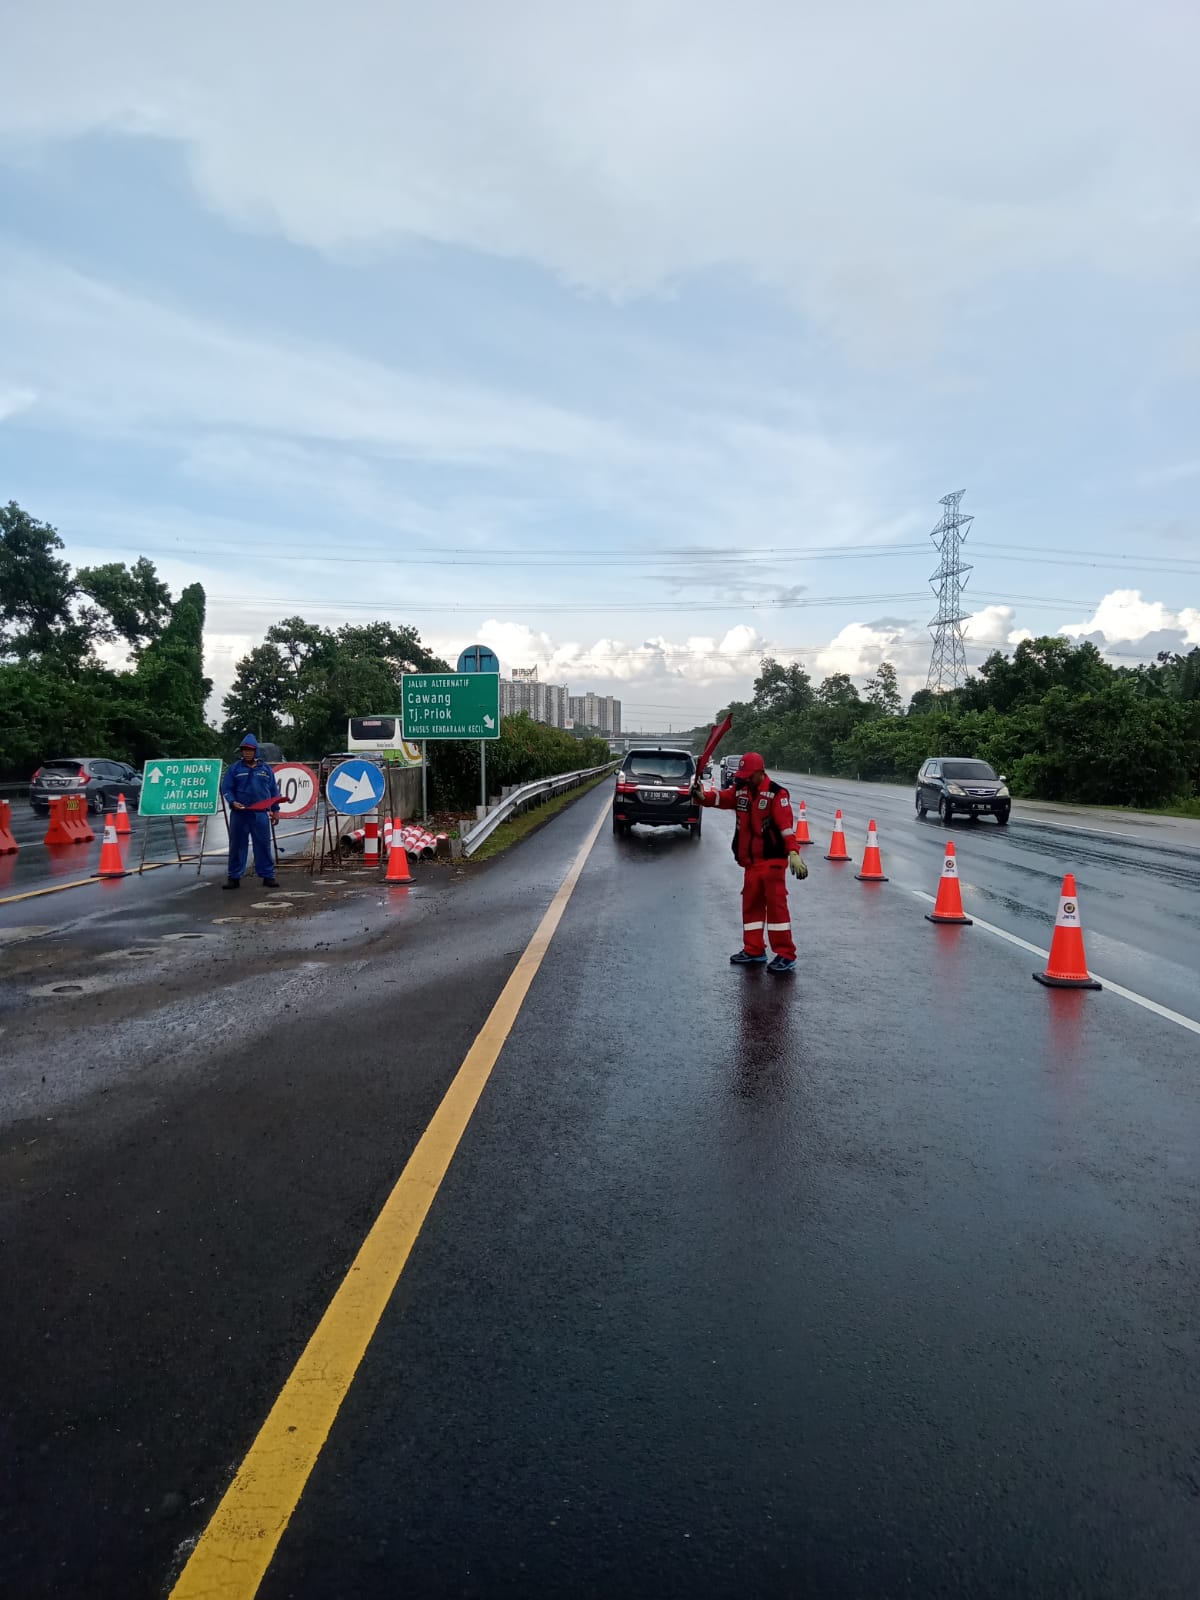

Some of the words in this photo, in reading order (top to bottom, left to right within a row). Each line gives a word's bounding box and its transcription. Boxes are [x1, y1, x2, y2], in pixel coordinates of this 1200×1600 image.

[408, 680, 427, 688] JALUR
[431, 679, 469, 688] ALTERNATIF
[407, 693, 451, 706] Cawang
[408, 708, 452, 722] Tj.Priok
[408, 725, 430, 733] KHUSUS
[432, 725, 466, 733] KENDARAAN
[468, 724, 484, 733] KECIL
[183, 764, 212, 774] INDAH
[180, 777, 206, 786] REBO
[298, 776, 310, 788] km
[164, 790, 184, 800] JATI
[186, 789, 209, 799] ASIH
[161, 802, 187, 811] LURUS
[189, 801, 214, 810] TERUS
